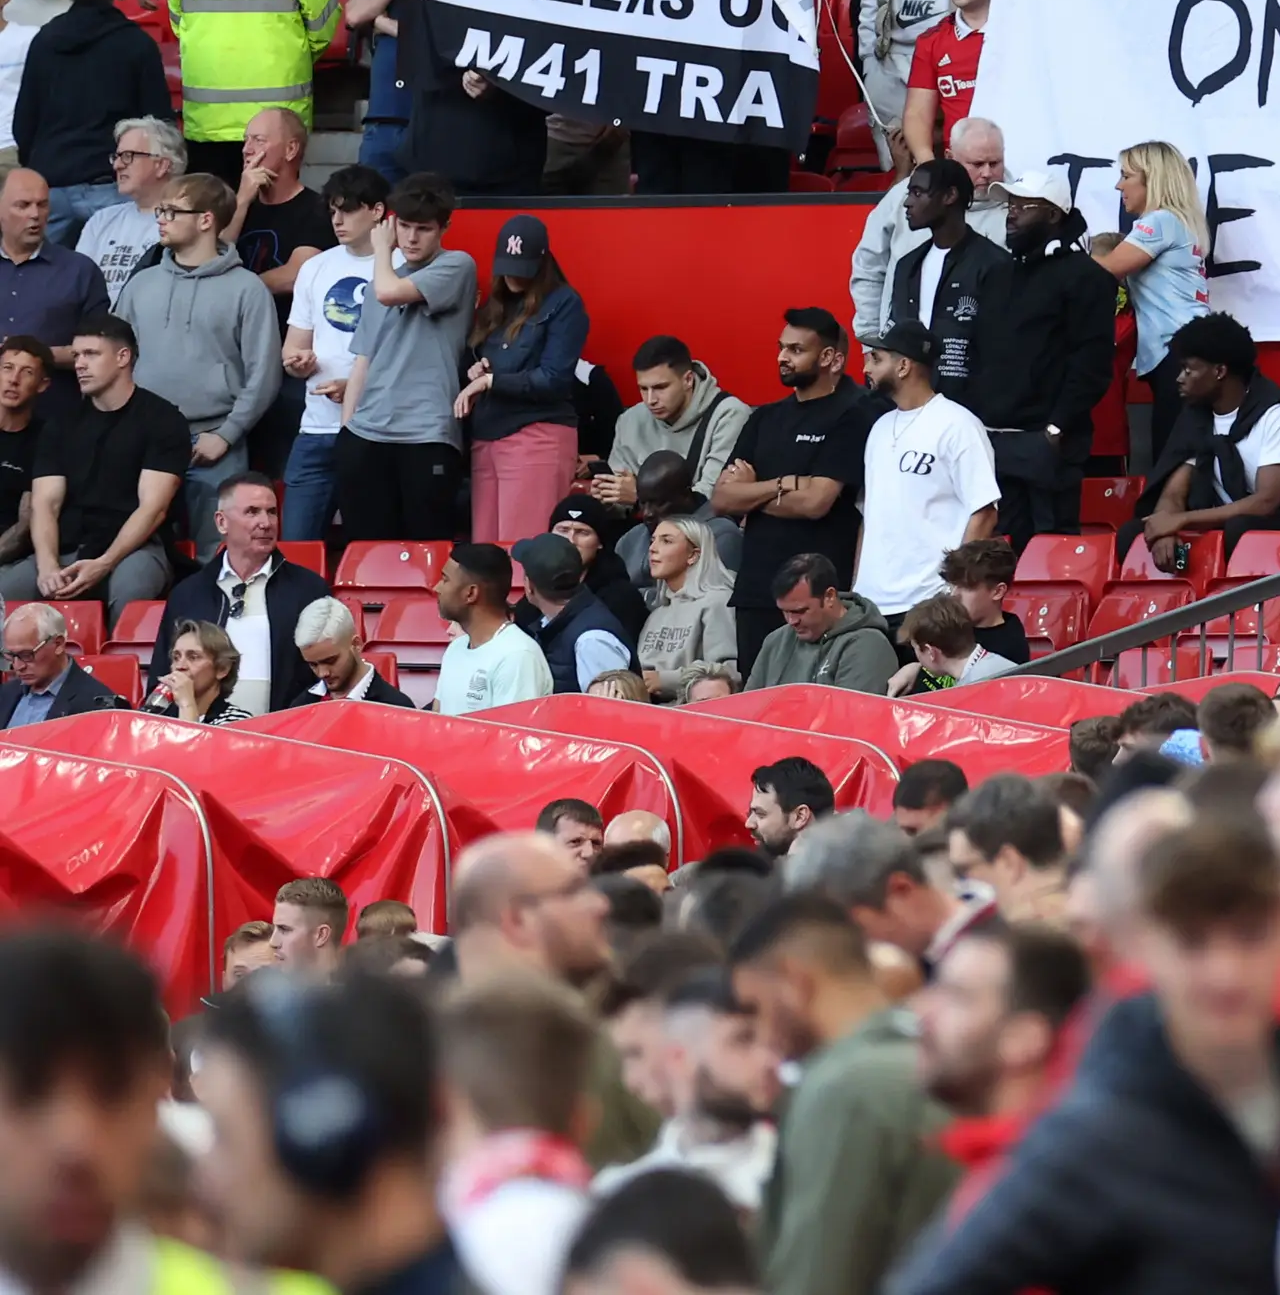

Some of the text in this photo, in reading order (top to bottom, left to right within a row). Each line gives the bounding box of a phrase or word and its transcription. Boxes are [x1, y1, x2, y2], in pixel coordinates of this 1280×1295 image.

[902, 0, 936, 16] NIKE
[455, 26, 785, 129] M41 TRA
[1048, 152, 1275, 278] TE
[115, 244, 132, 254] THE
[899, 449, 936, 476] CB
